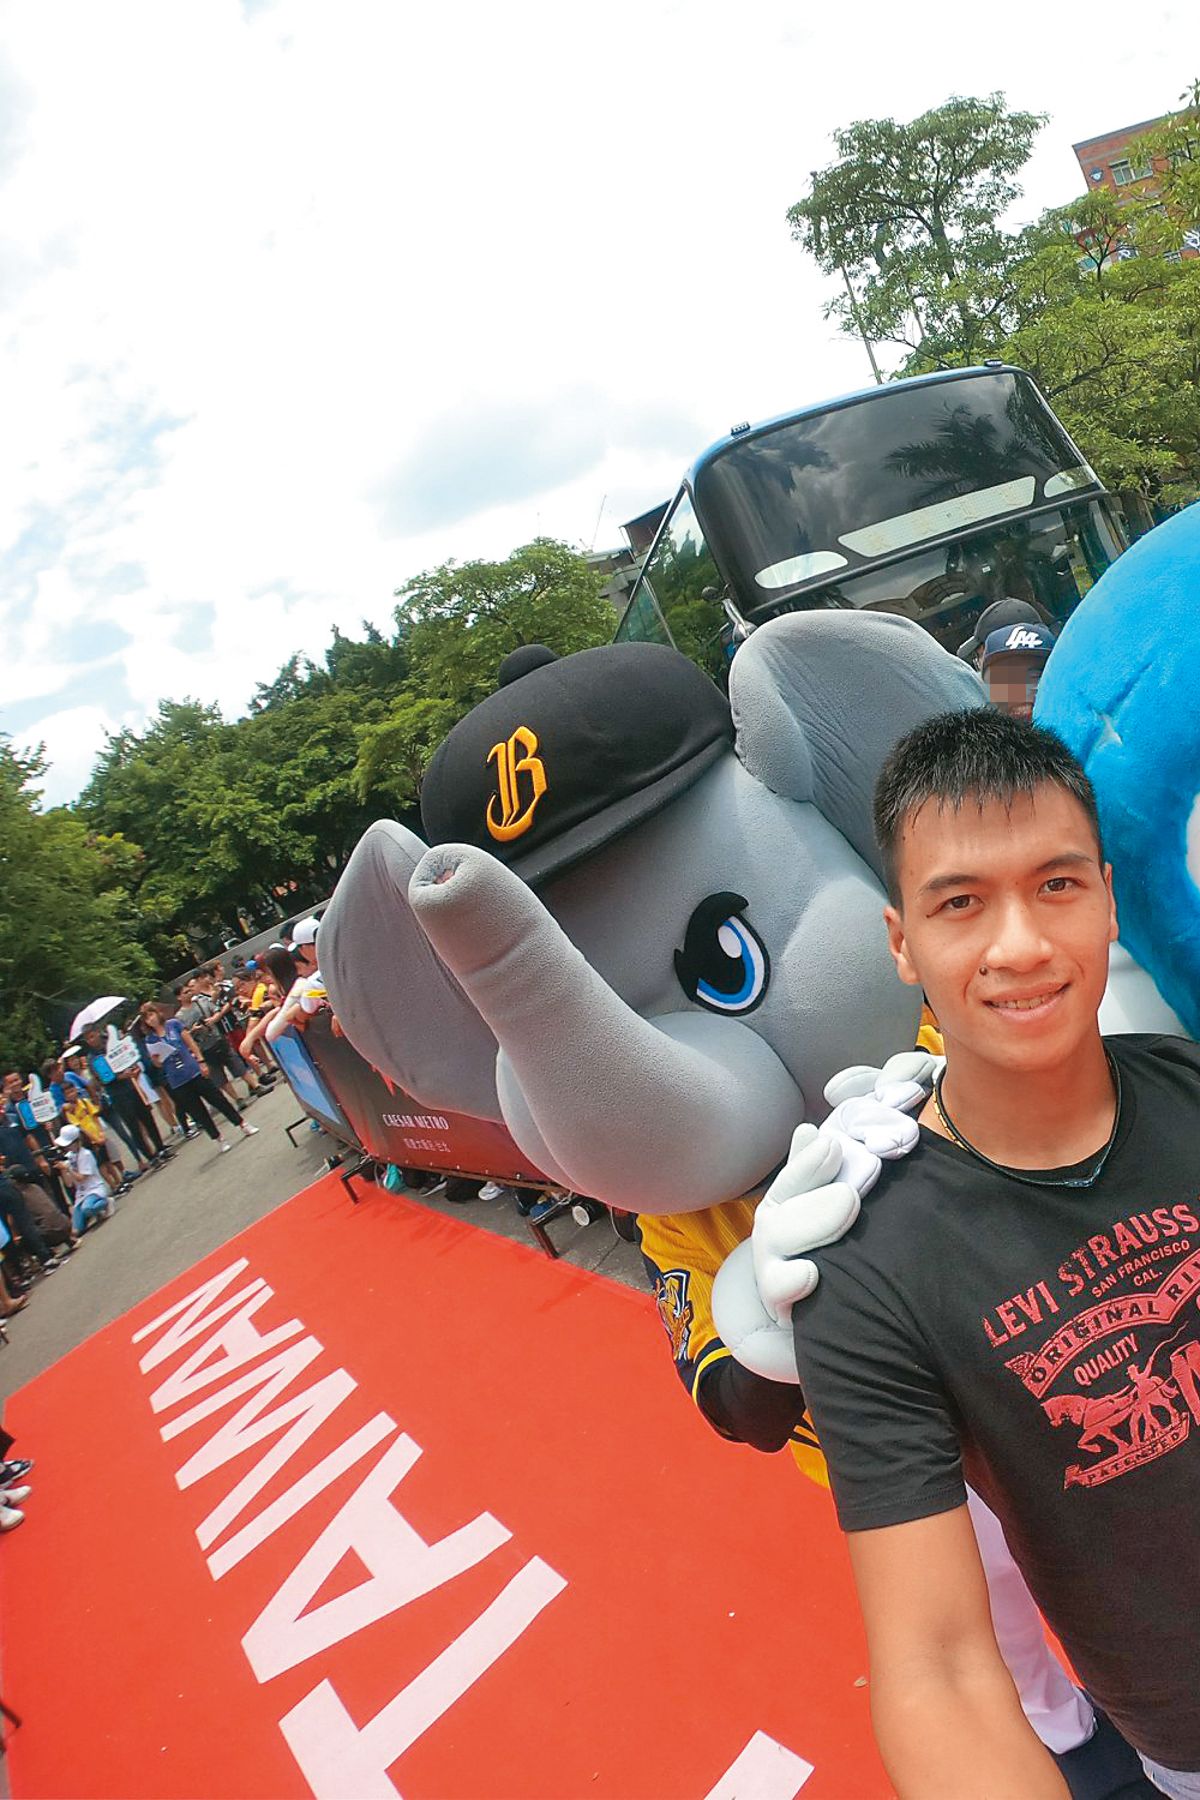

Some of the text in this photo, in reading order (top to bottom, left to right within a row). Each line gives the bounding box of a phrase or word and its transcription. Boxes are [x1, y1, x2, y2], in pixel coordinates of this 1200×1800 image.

[486, 725, 548, 843] B
[414, 1115, 450, 1130] METRO
[982, 1280, 1060, 1348] LEVI
[1057, 1204, 1200, 1297] STRAUSS
[1091, 1239, 1191, 1298] SAN FRANCISCO
[1133, 1270, 1163, 1287] CAL.
[1031, 1300, 1160, 1383] ORIGINAL
[1073, 1333, 1140, 1386] QUALITY
[1087, 1432, 1180, 1483] PATENTED
[131, 1257, 568, 1800] TAIWAN
